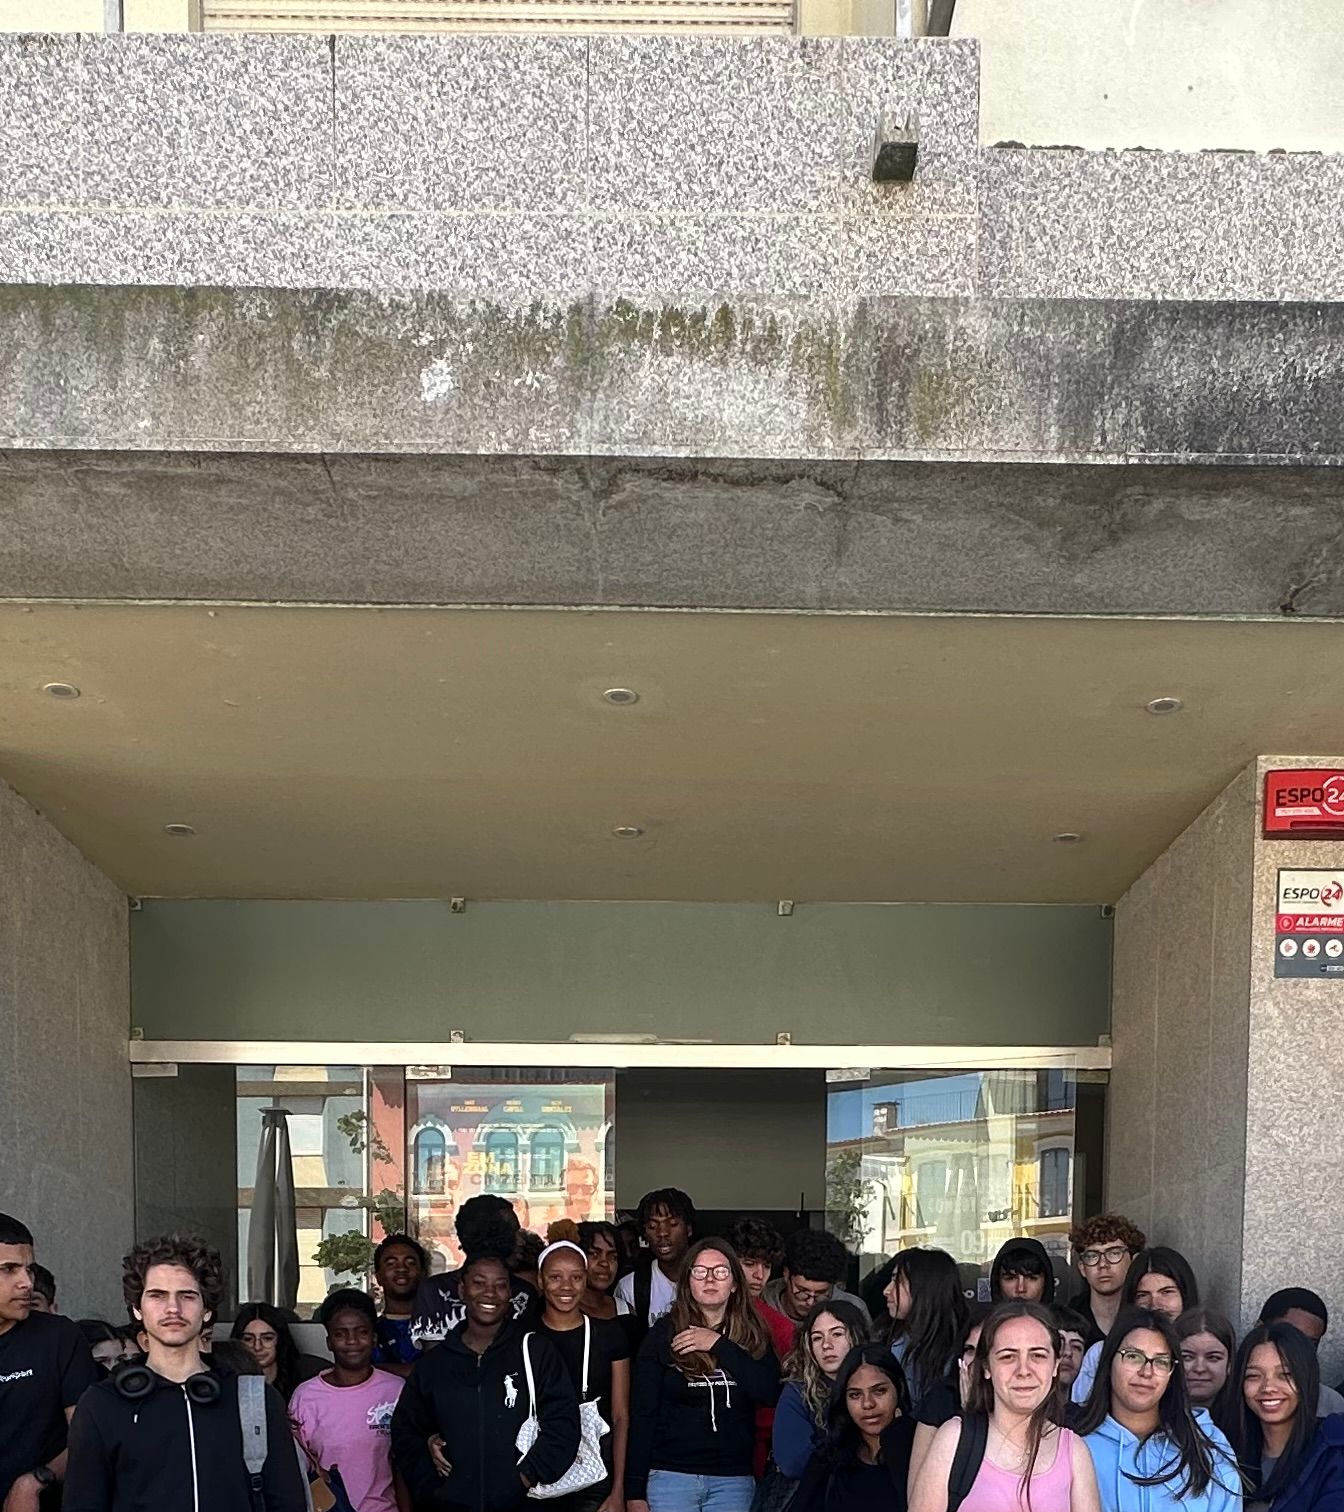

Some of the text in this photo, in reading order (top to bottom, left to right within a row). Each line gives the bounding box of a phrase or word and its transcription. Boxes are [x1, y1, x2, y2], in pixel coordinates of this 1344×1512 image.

[1276, 788, 1324, 806] ESPO
[1283, 887, 1342, 901] ESPO 24
[1296, 917, 1344, 927] ALARME
